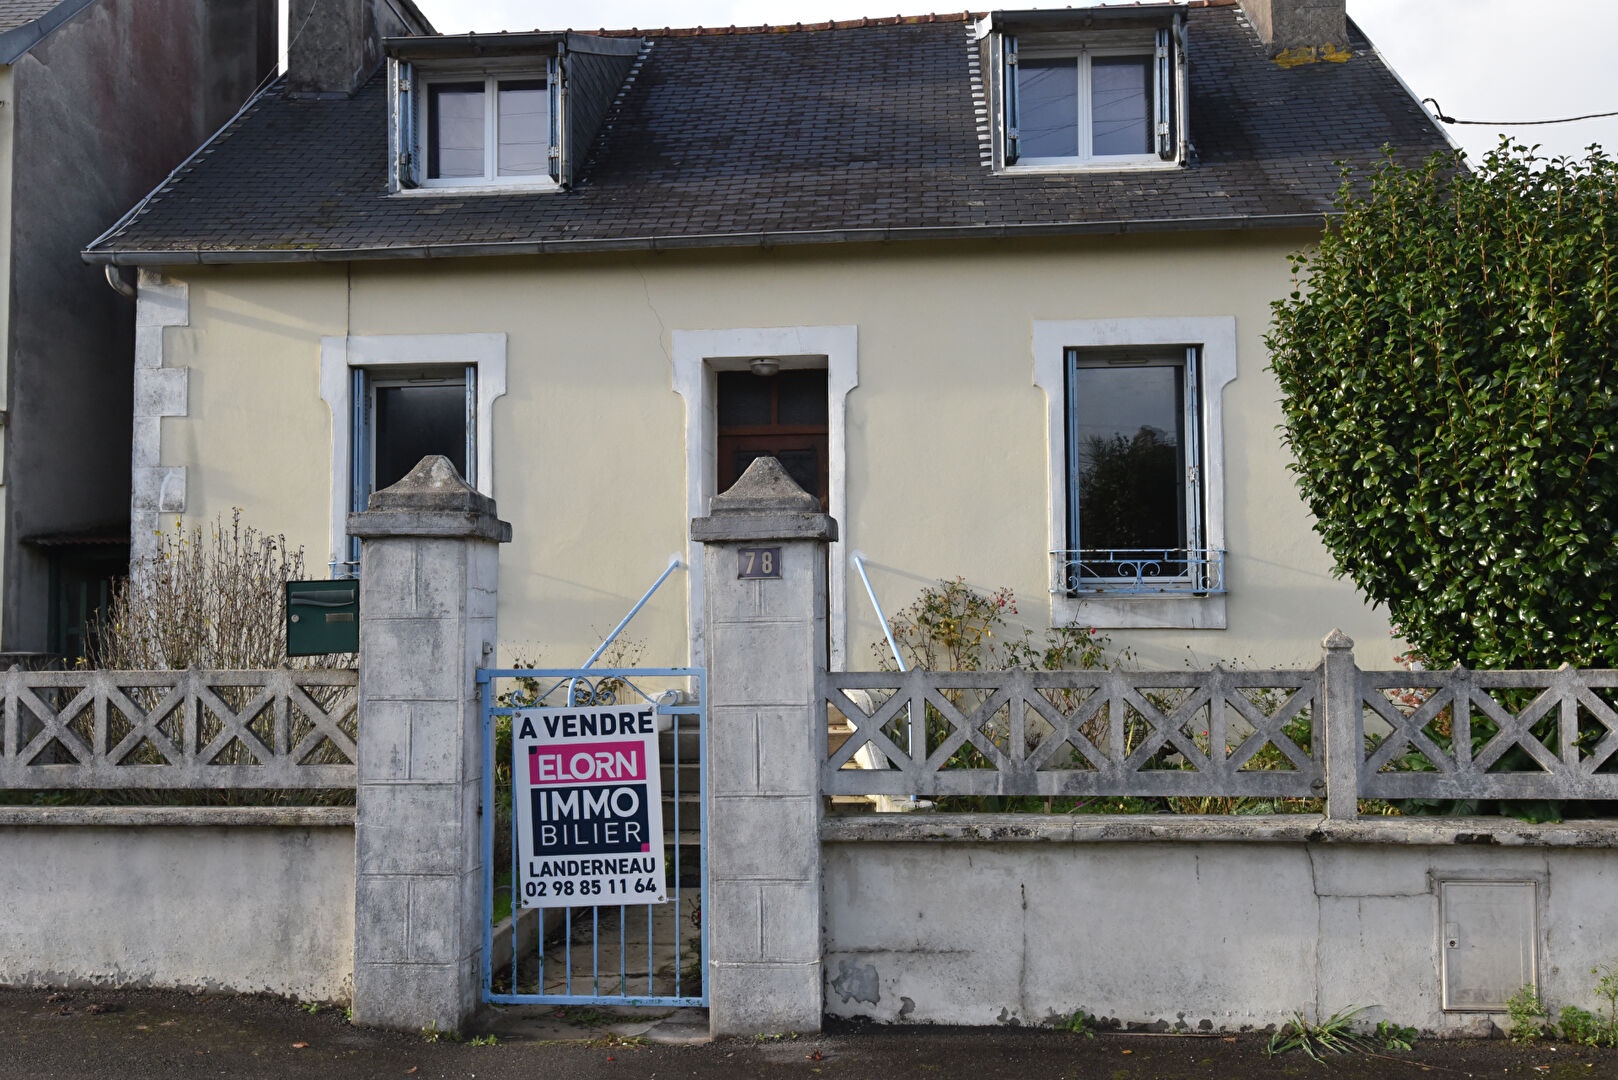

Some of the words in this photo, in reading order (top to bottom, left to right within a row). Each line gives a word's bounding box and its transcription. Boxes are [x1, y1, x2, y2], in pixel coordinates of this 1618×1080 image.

[745, 551, 773, 574] 78
[518, 717, 537, 739] A
[543, 711, 654, 738] VENDRE
[538, 750, 638, 781] ELORN
[539, 787, 640, 821] IMMO
[541, 822, 642, 846] BILIER
[529, 857, 656, 878] LANDERNEAU
[525, 881, 547, 897] 02
[552, 880, 574, 896] 98
[579, 879, 601, 895] 85
[608, 878, 627, 894] 11
[634, 877, 657, 893] 64
